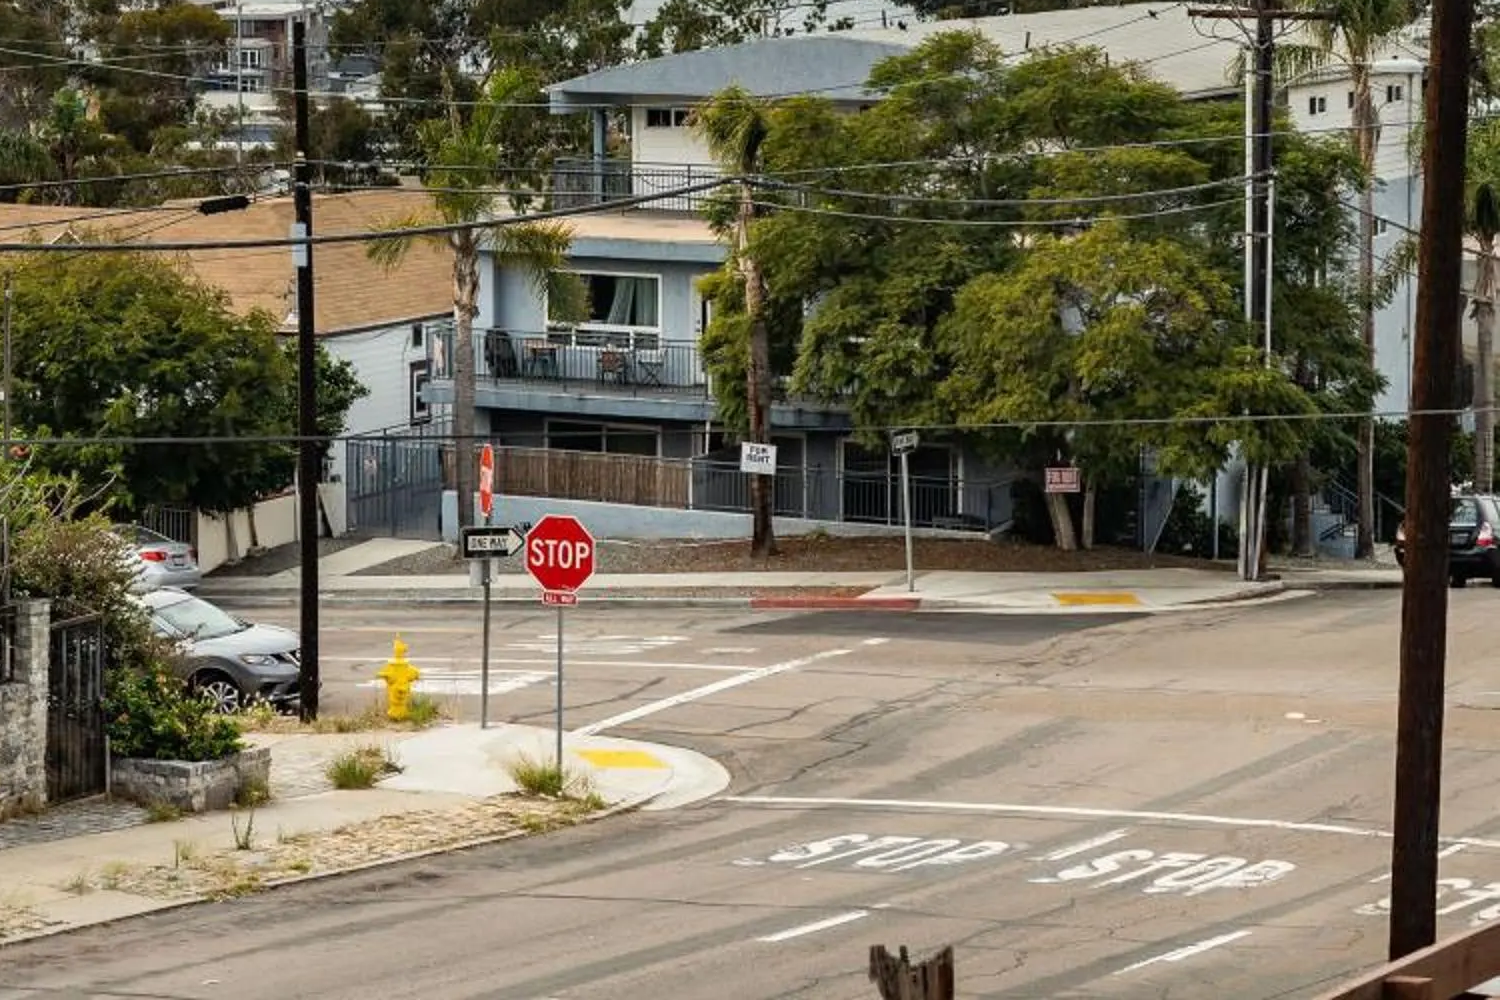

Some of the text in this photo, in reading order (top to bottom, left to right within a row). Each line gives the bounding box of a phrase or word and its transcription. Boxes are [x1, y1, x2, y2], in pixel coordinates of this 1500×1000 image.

[471, 537, 508, 549] ONE WAY
[530, 538, 590, 569] STOP
[732, 833, 1009, 873] STOP
[1028, 849, 1297, 897] STOP
